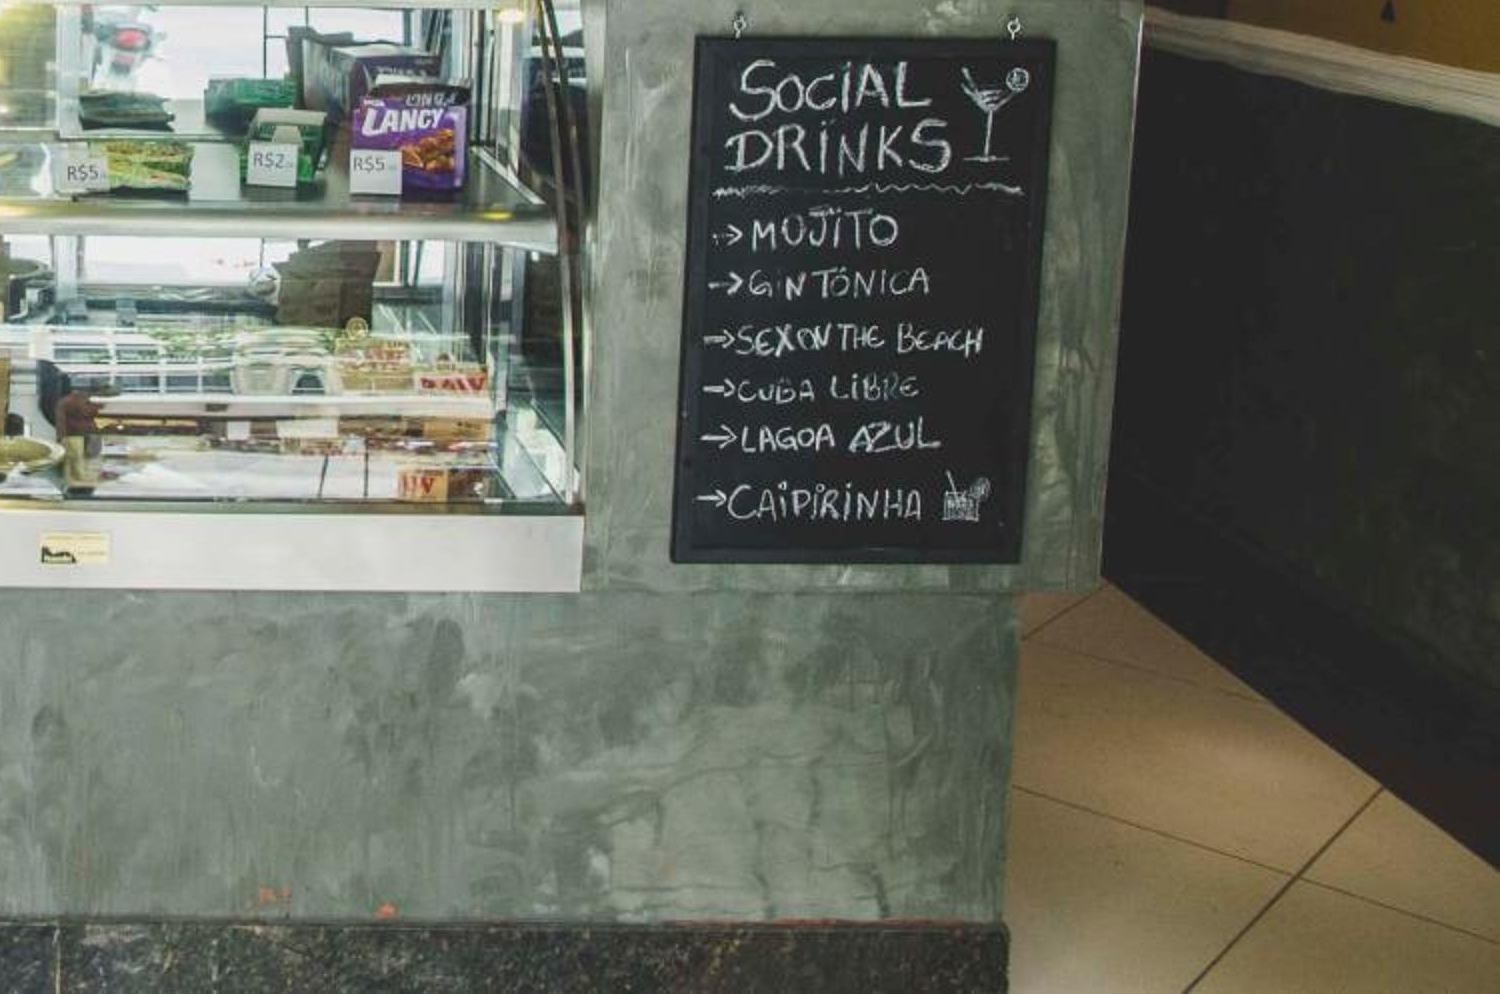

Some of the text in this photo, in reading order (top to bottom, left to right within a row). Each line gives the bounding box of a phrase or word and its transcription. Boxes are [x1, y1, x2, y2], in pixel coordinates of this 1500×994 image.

[729, 59, 932, 121] SOCIAL
[362, 108, 444, 137] LANCY
[724, 118, 952, 177] DRINKS
[751, 208, 899, 252] MOJITO
[748, 272, 806, 302] GIN
[735, 322, 985, 358] SEX ON THE BEACH
[737, 379, 816, 404] CUBA
[740, 415, 942, 454] LAGOA AZUL
[726, 481, 923, 522] CAIPIRINHA
